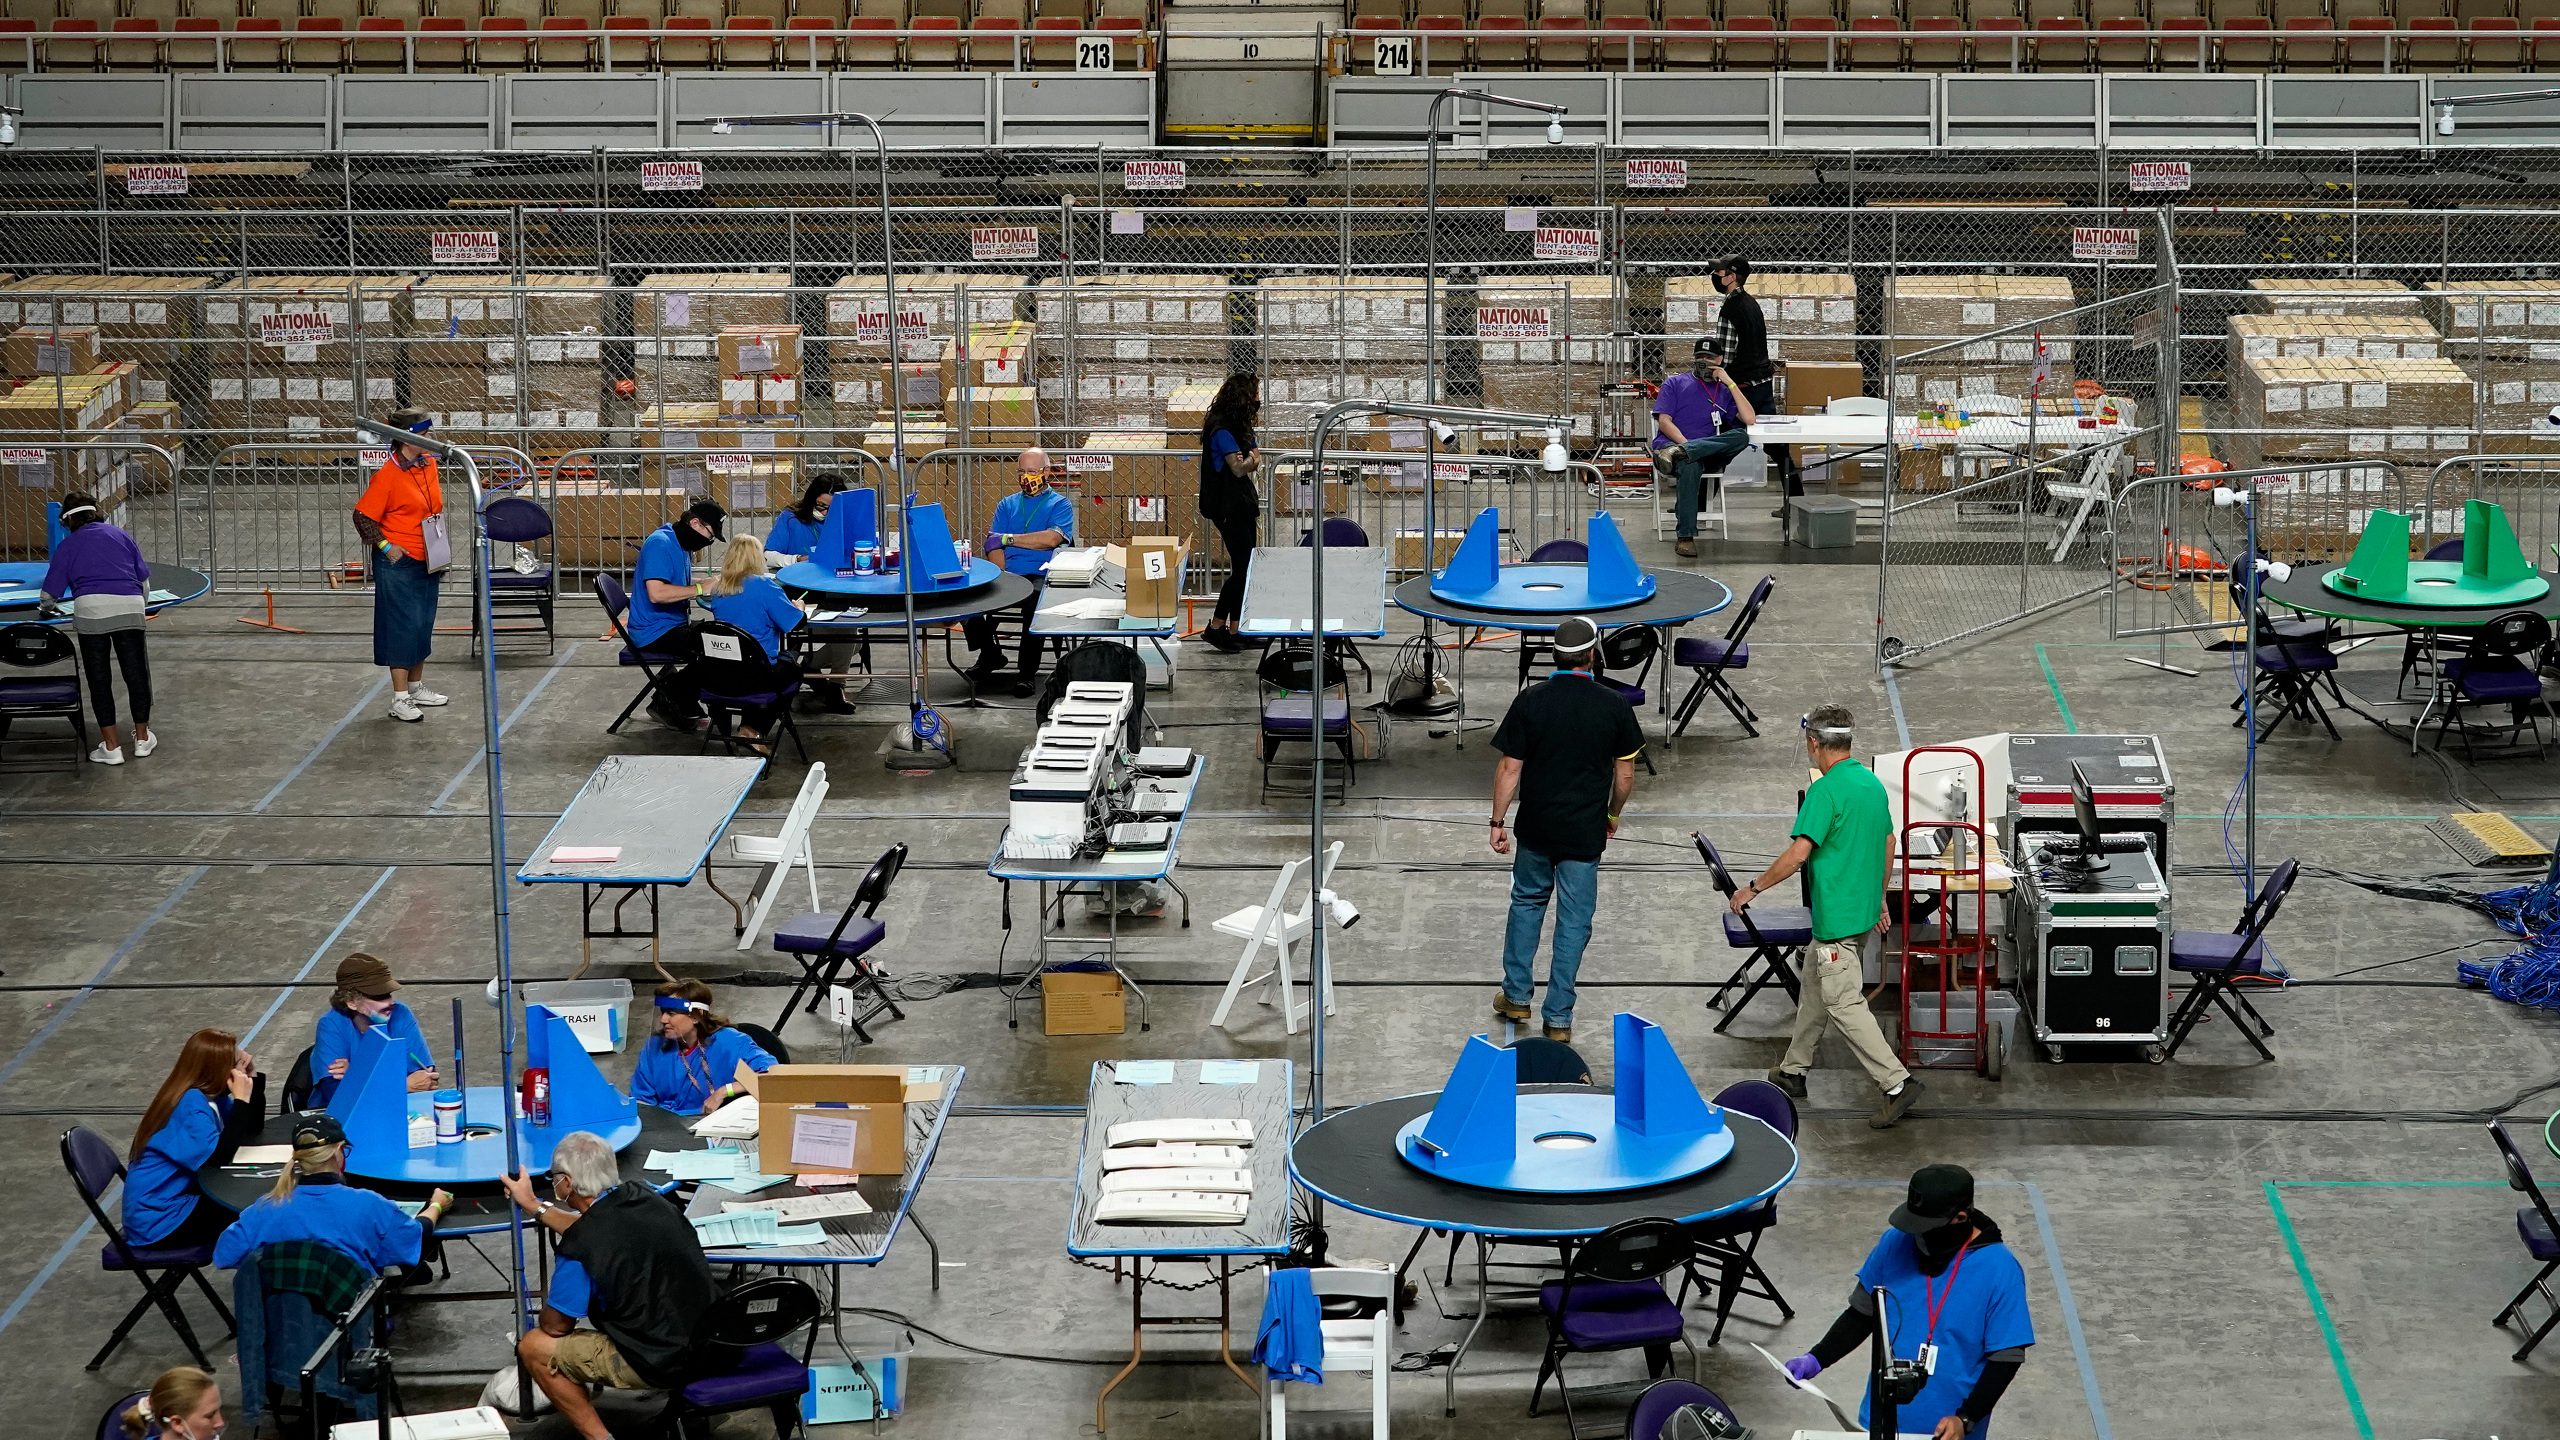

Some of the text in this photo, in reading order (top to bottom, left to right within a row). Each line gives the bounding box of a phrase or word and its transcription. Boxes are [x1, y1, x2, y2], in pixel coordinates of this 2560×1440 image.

[1080, 43, 1110, 68] 213
[1244, 44, 1259, 58] 10
[1378, 44, 1408, 68] 214
[130, 167, 186, 180] NATIONAL
[643, 163, 701, 176] NATIONAL
[1126, 162, 1184, 175] NATIONAL
[1628, 161, 1686, 173] NATIONAL
[2131, 163, 2188, 176] NATIONAL
[434, 233, 496, 247] NATIONAL
[973, 229, 1036, 243] NATIONAL
[1536, 229, 1599, 245] NATIONAL
[2075, 229, 2137, 243] NATIONAL
[262, 313, 332, 330] NATIONAL
[1479, 309, 1548, 324] NATIONAL
[265, 334, 333, 342] 800-352-5675
[362, 451, 390, 459] NATIO
[708, 455, 751, 463] NATIONAL
[1069, 455, 1111, 463] NATIONAL
[1433, 464, 1468, 473] ATIONAL
[2253, 475, 2290, 484] NATIONAL
[1151, 558, 1161, 572] 5
[711, 640, 732, 650] WCA
[837, 997, 846, 1016] 1
[2095, 1017, 2111, 1027] 96
[820, 1383, 870, 1394] SUPPLIE
